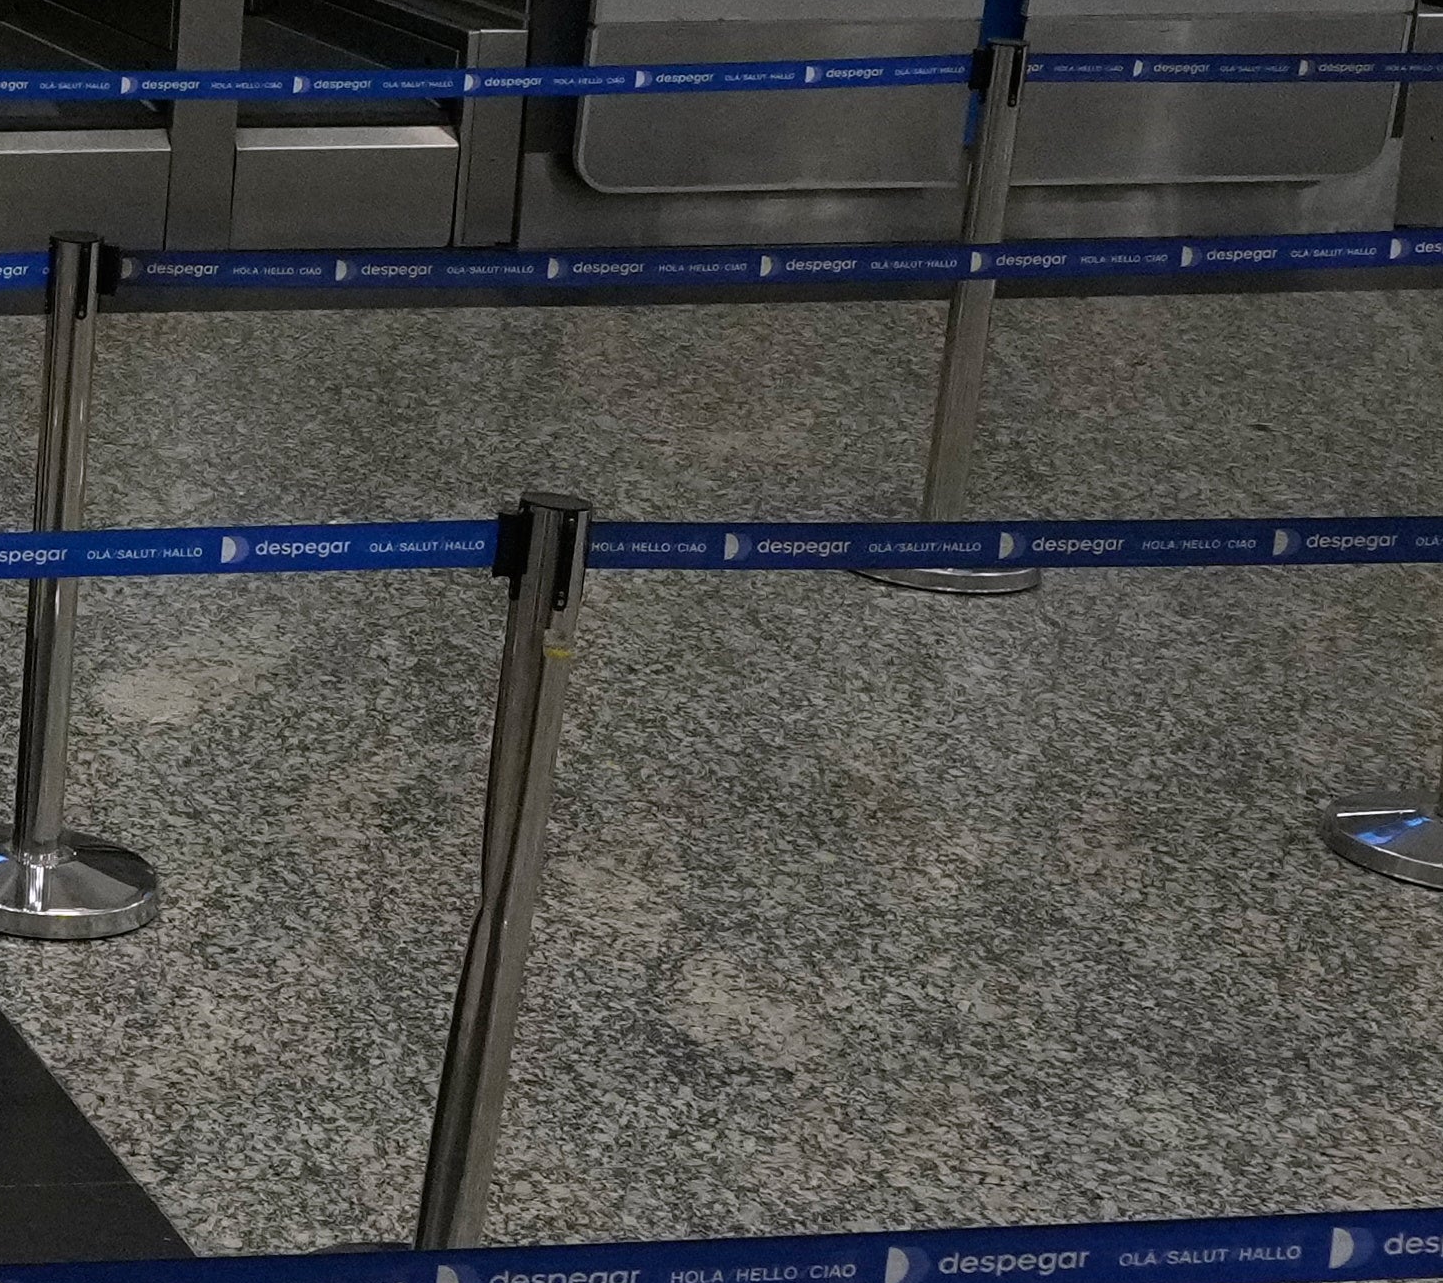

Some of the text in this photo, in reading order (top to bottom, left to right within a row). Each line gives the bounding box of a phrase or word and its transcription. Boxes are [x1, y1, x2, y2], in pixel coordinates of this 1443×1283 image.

[142, 80, 199, 91] despegar
[314, 81, 371, 91] despegar
[147, 249, 1277, 278] despegar despegar despegar despegar despegar despegar
[256, 541, 350, 558] despegar
[757, 539, 851, 557] despegar
[1033, 536, 1124, 555] despegar
[1307, 534, 1397, 551] despegar
[938, 1250, 1090, 1277] despegar
